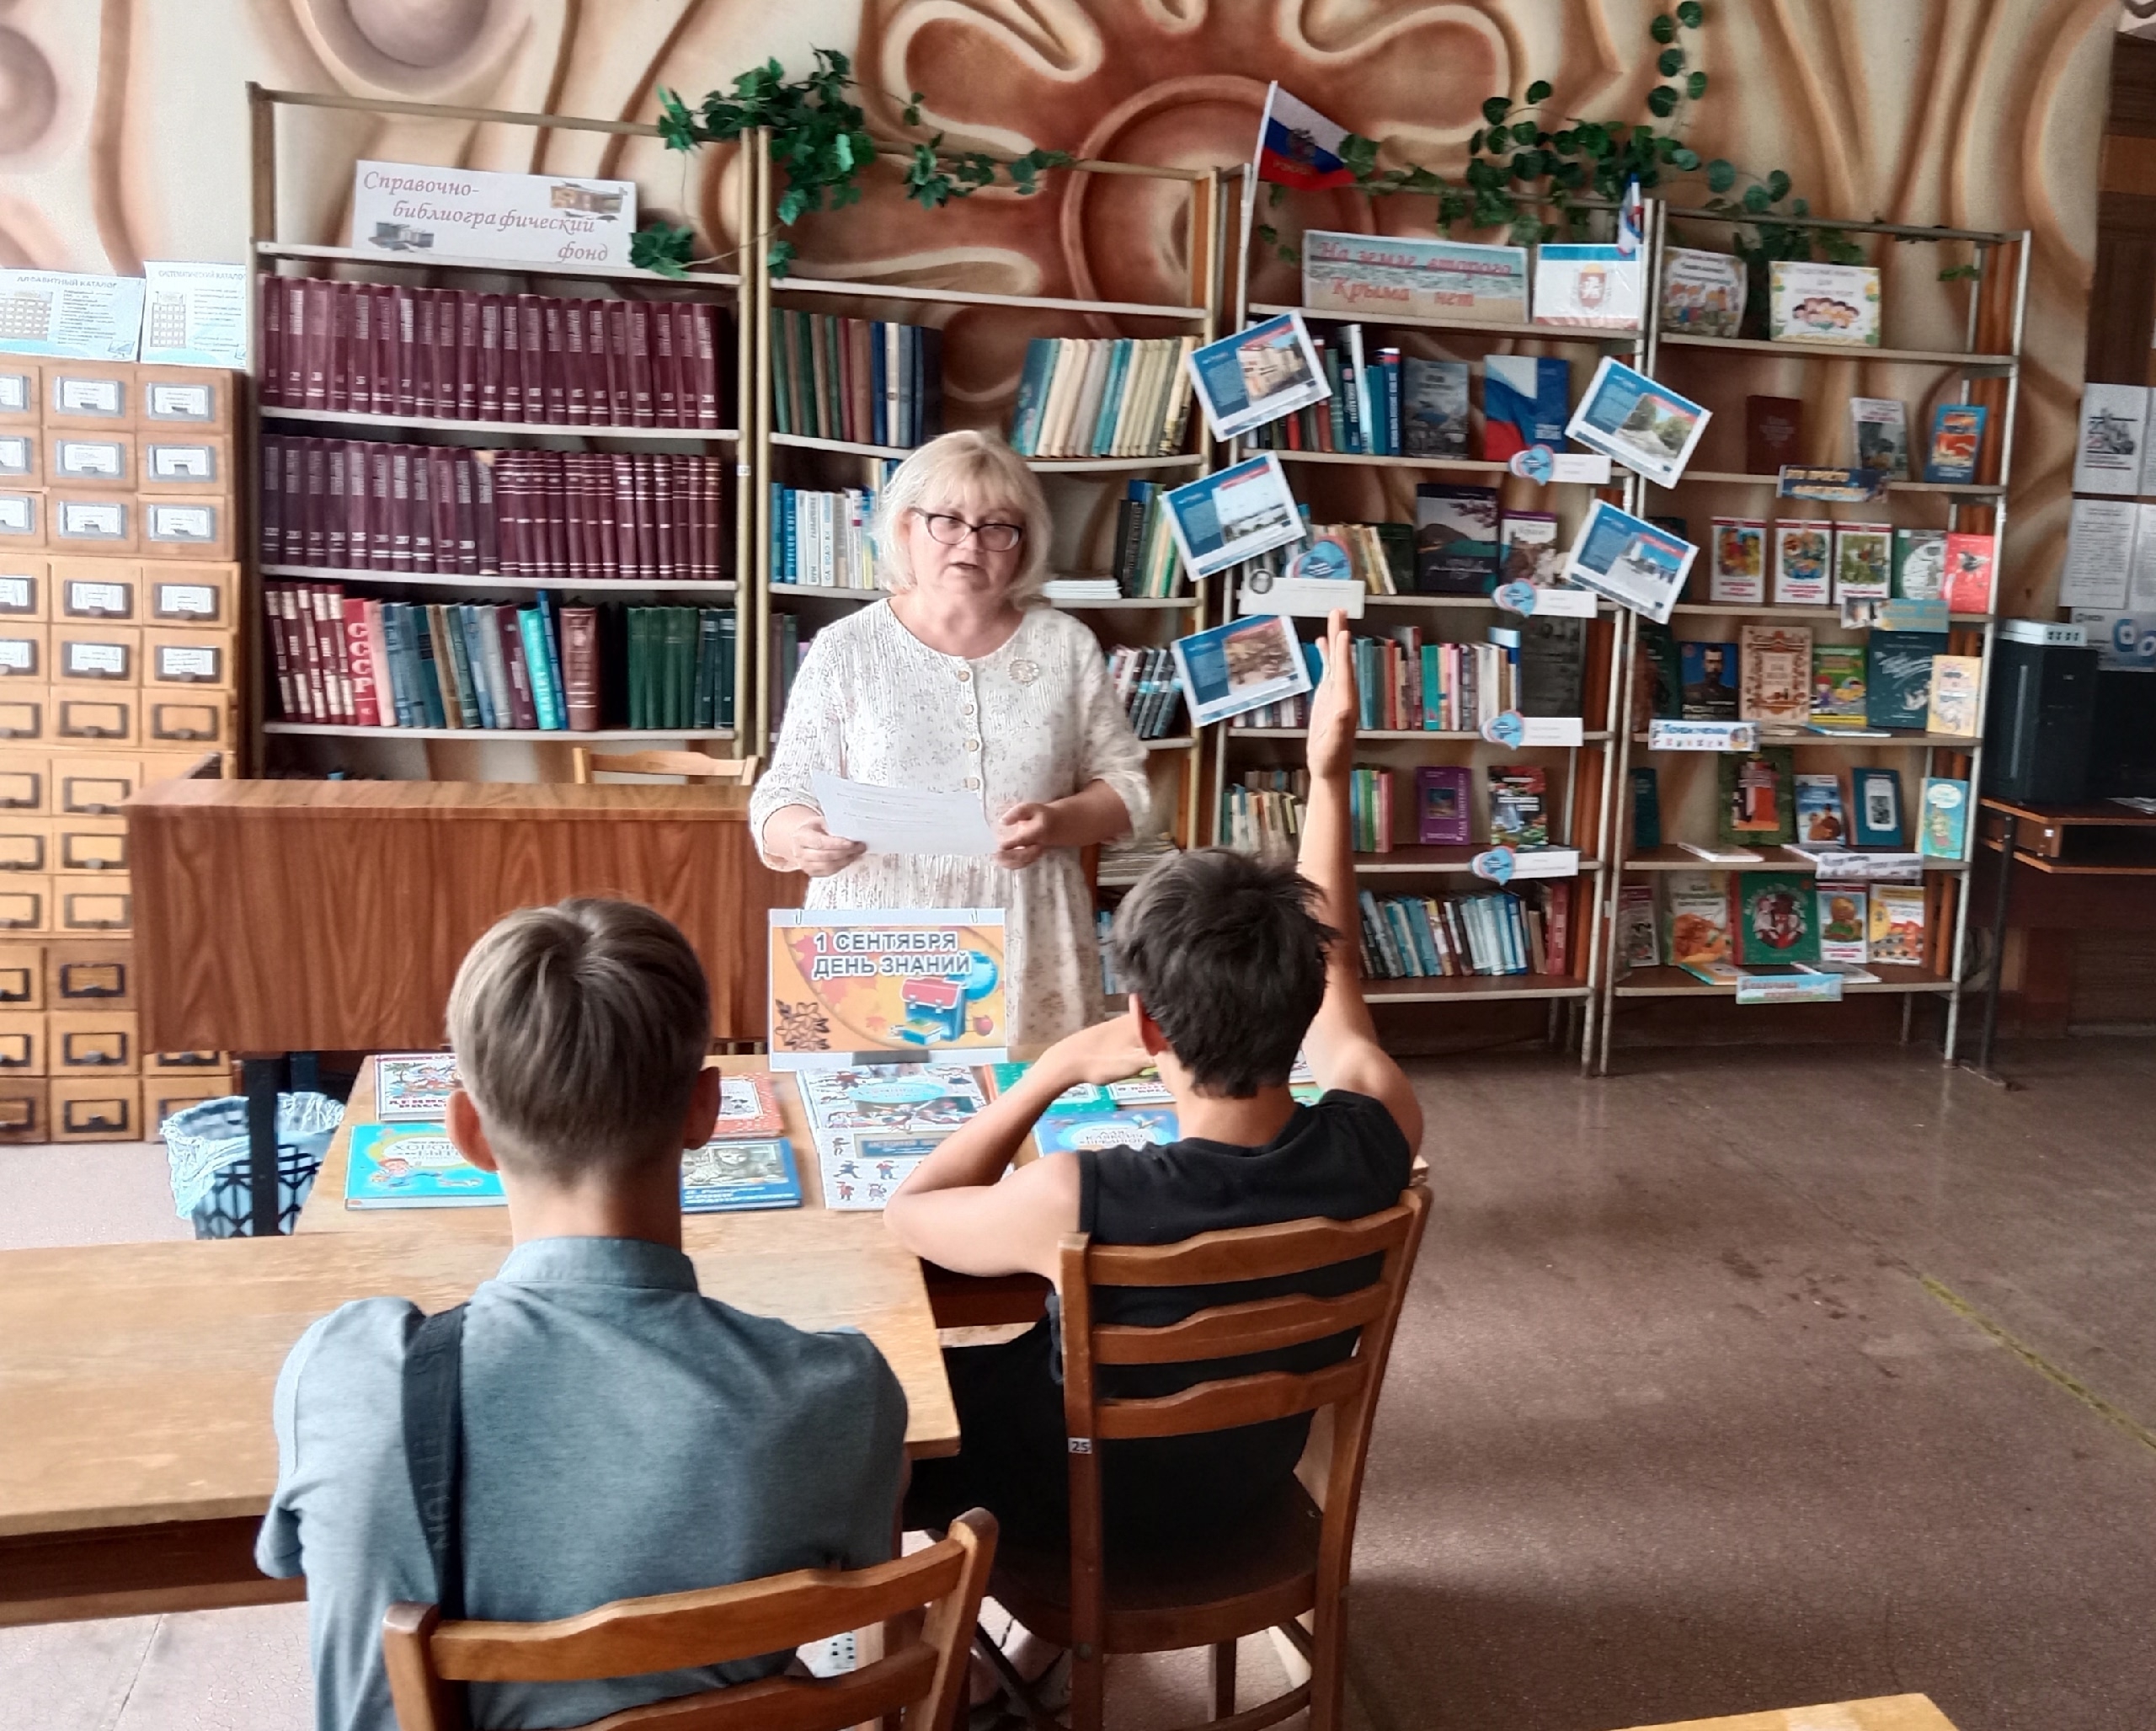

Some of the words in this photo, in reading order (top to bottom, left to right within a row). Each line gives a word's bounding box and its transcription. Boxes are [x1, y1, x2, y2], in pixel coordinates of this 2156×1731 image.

[363, 171, 480, 197] Справочно-
[392, 200, 595, 235] библиографический
[557, 241, 609, 263] фонд
[80, 280, 118, 290] КАТАЛОГ
[347, 622, 374, 693] СССР
[814, 933, 825, 951] 1
[835, 932, 957, 950] СЕНТЯБРЯ
[813, 957, 875, 978] ДЕНЬ
[881, 952, 970, 974] ЗНАНИЙ
[1071, 1440, 1090, 1453] 25
